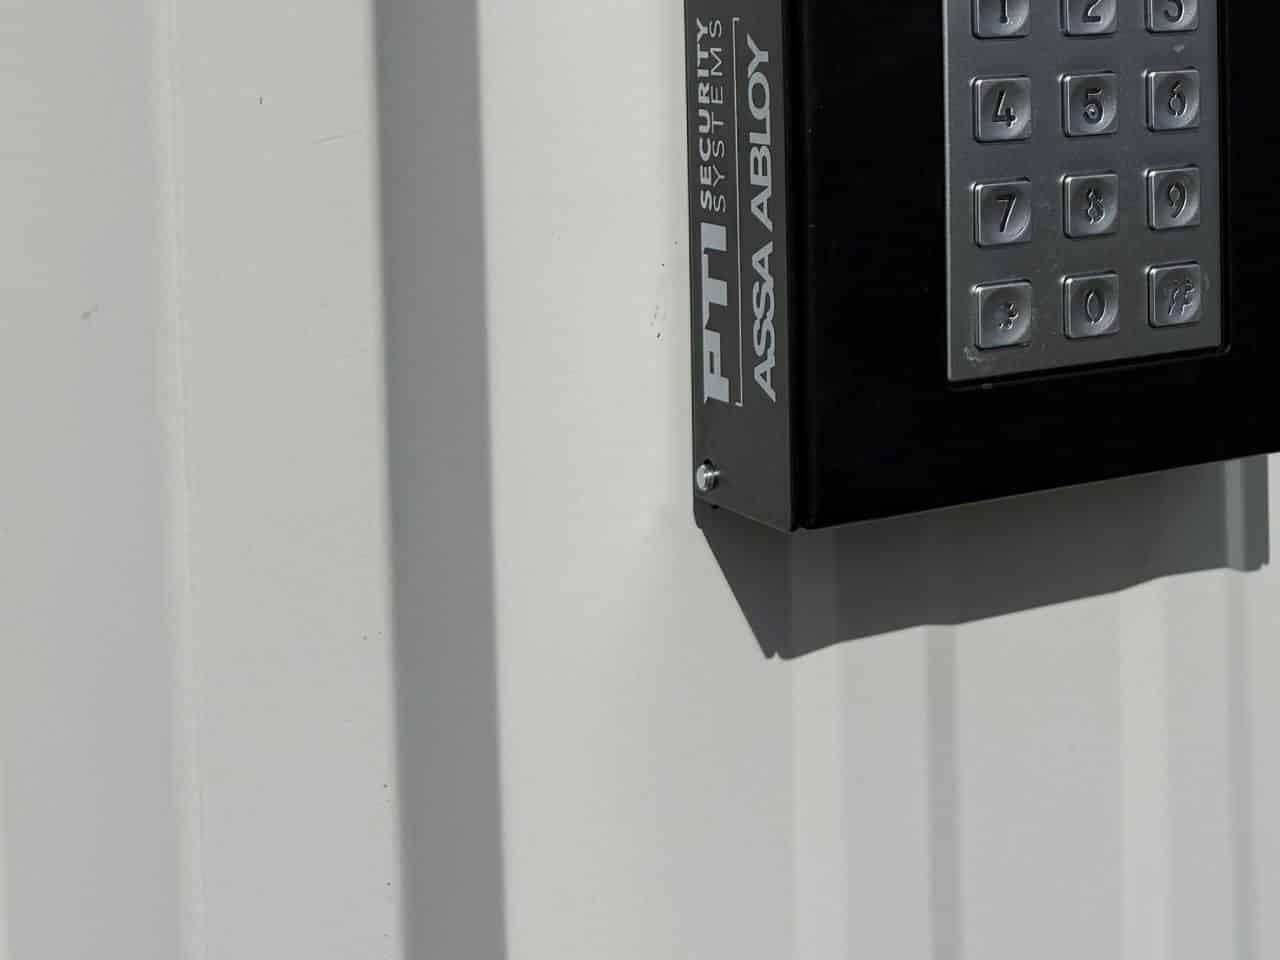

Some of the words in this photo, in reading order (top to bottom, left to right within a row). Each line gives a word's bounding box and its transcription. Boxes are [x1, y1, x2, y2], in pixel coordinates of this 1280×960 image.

[696, 17, 714, 211] SECURITY
[710, 19, 726, 213] SYSTEMS
[746, 33, 773, 232] ABLOY
[991, 88, 1017, 128] 4
[1083, 87, 1105, 124] 5
[1167, 81, 1188, 119] 6
[996, 191, 1017, 233] 7
[1168, 182, 1188, 218] 9
[701, 222, 729, 403] PTI
[751, 241, 776, 402] ASSA
[1084, 290, 1106, 327] 0
